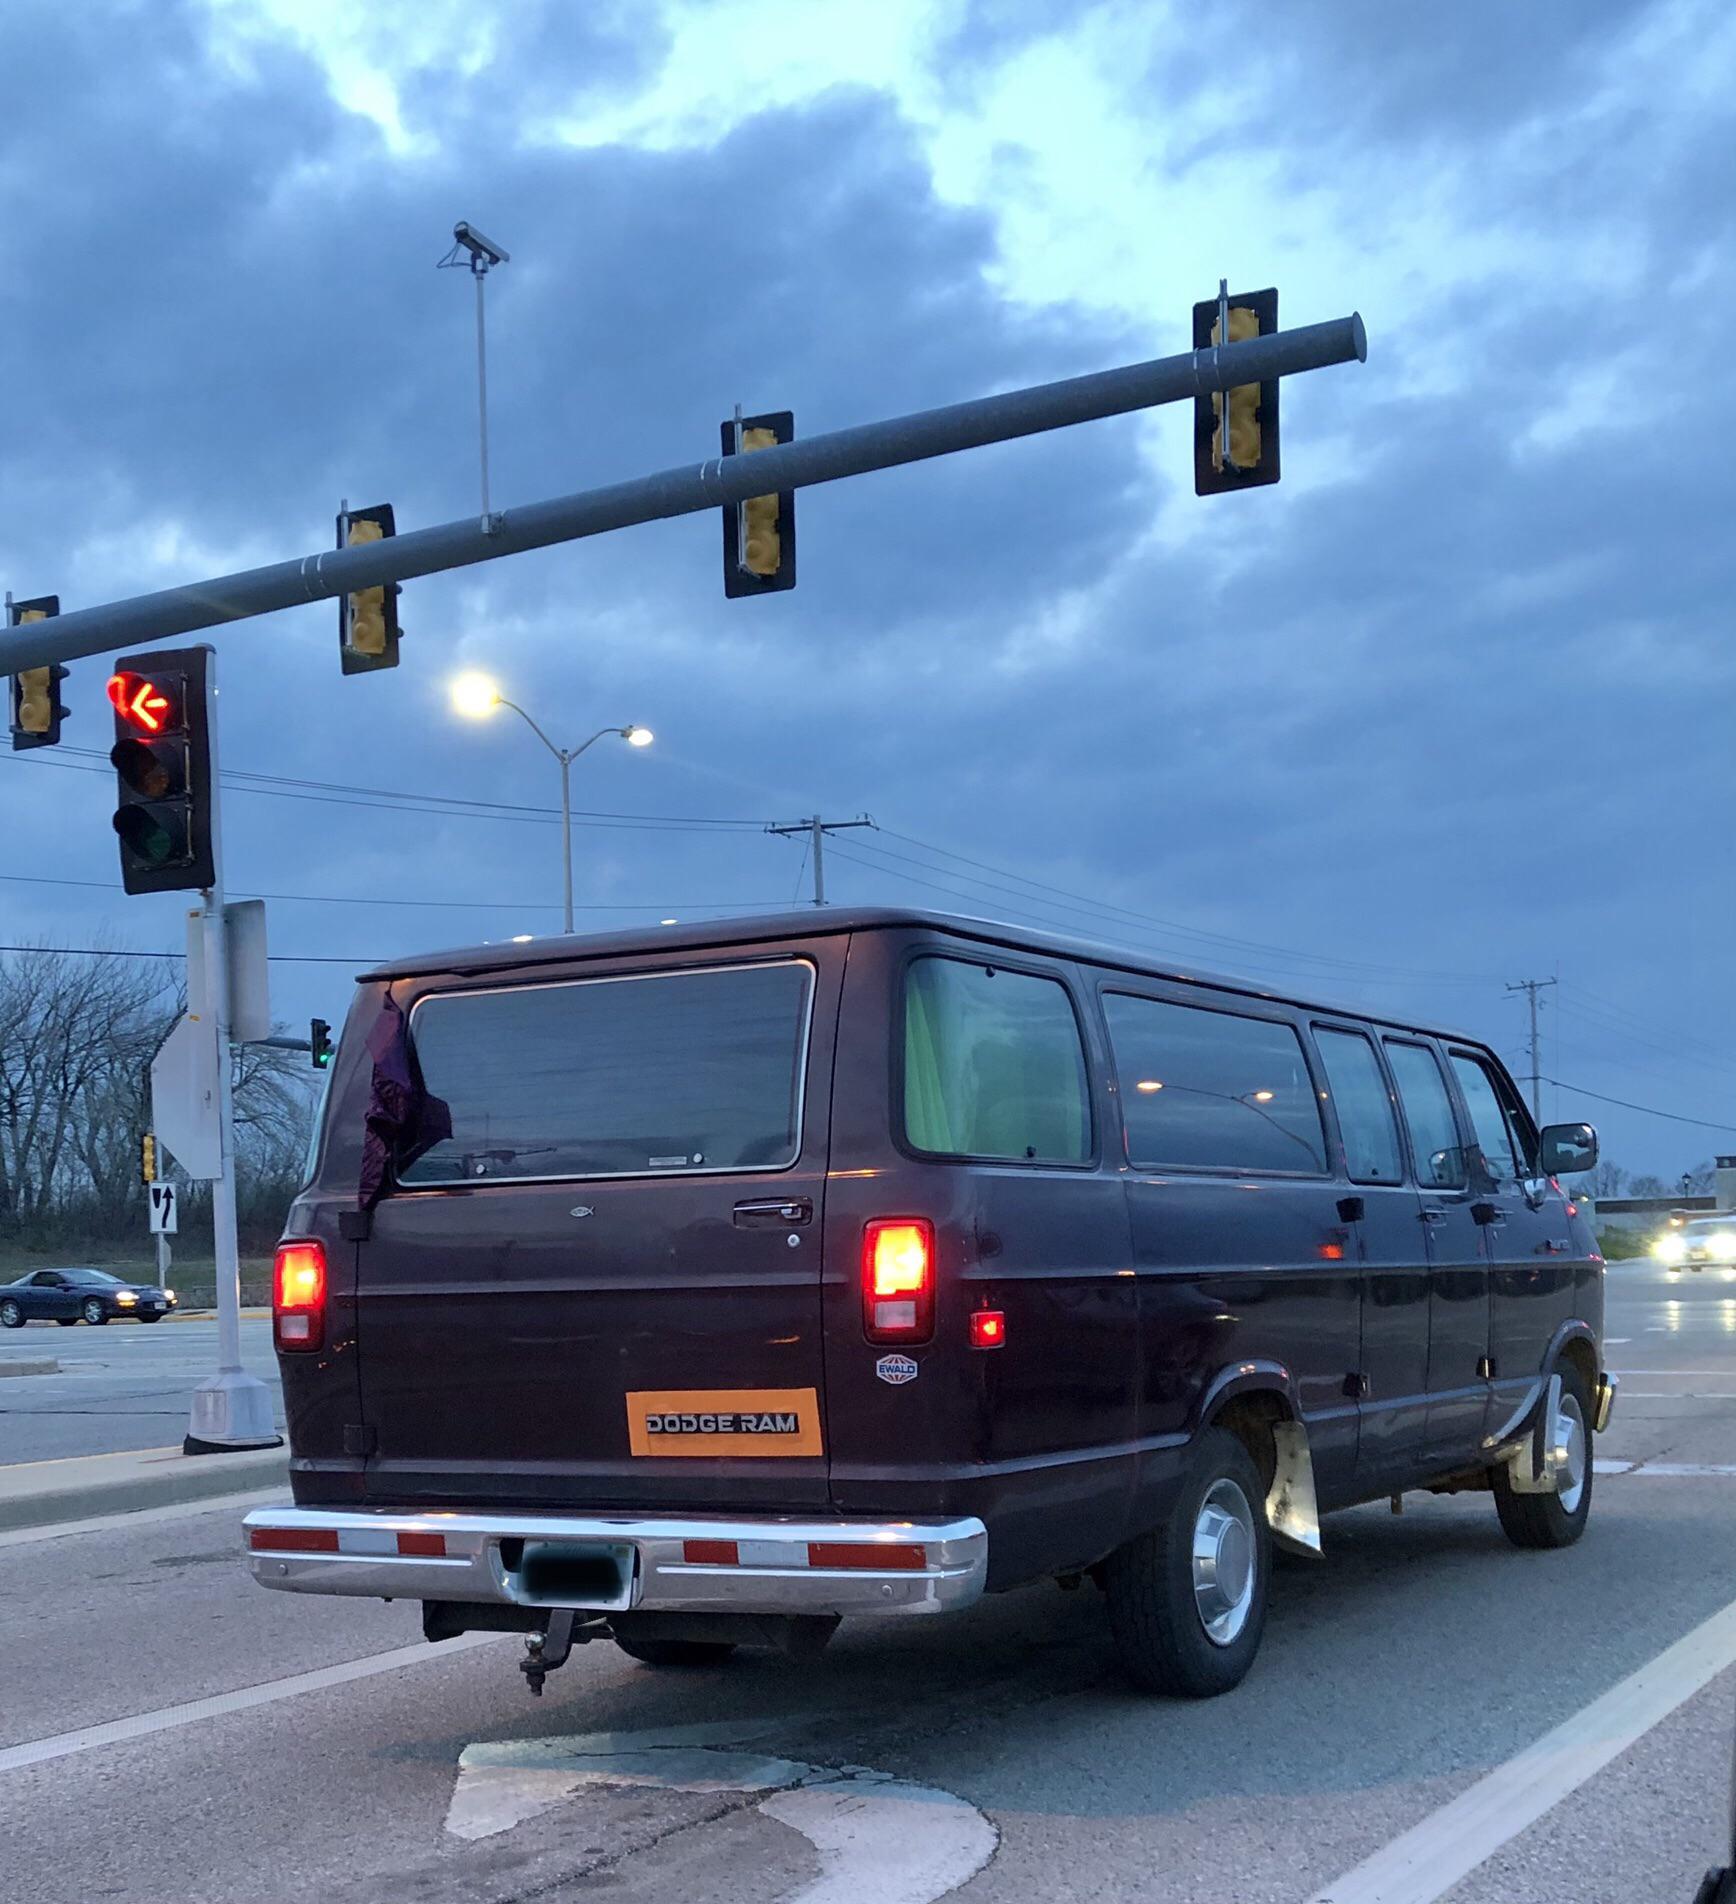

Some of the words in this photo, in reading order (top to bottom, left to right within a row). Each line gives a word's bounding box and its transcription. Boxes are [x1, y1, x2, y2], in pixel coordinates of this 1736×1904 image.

[879, 1365, 915, 1373] EWALD
[646, 1414, 734, 1432] DODGE
[741, 1414, 796, 1432] RAM
